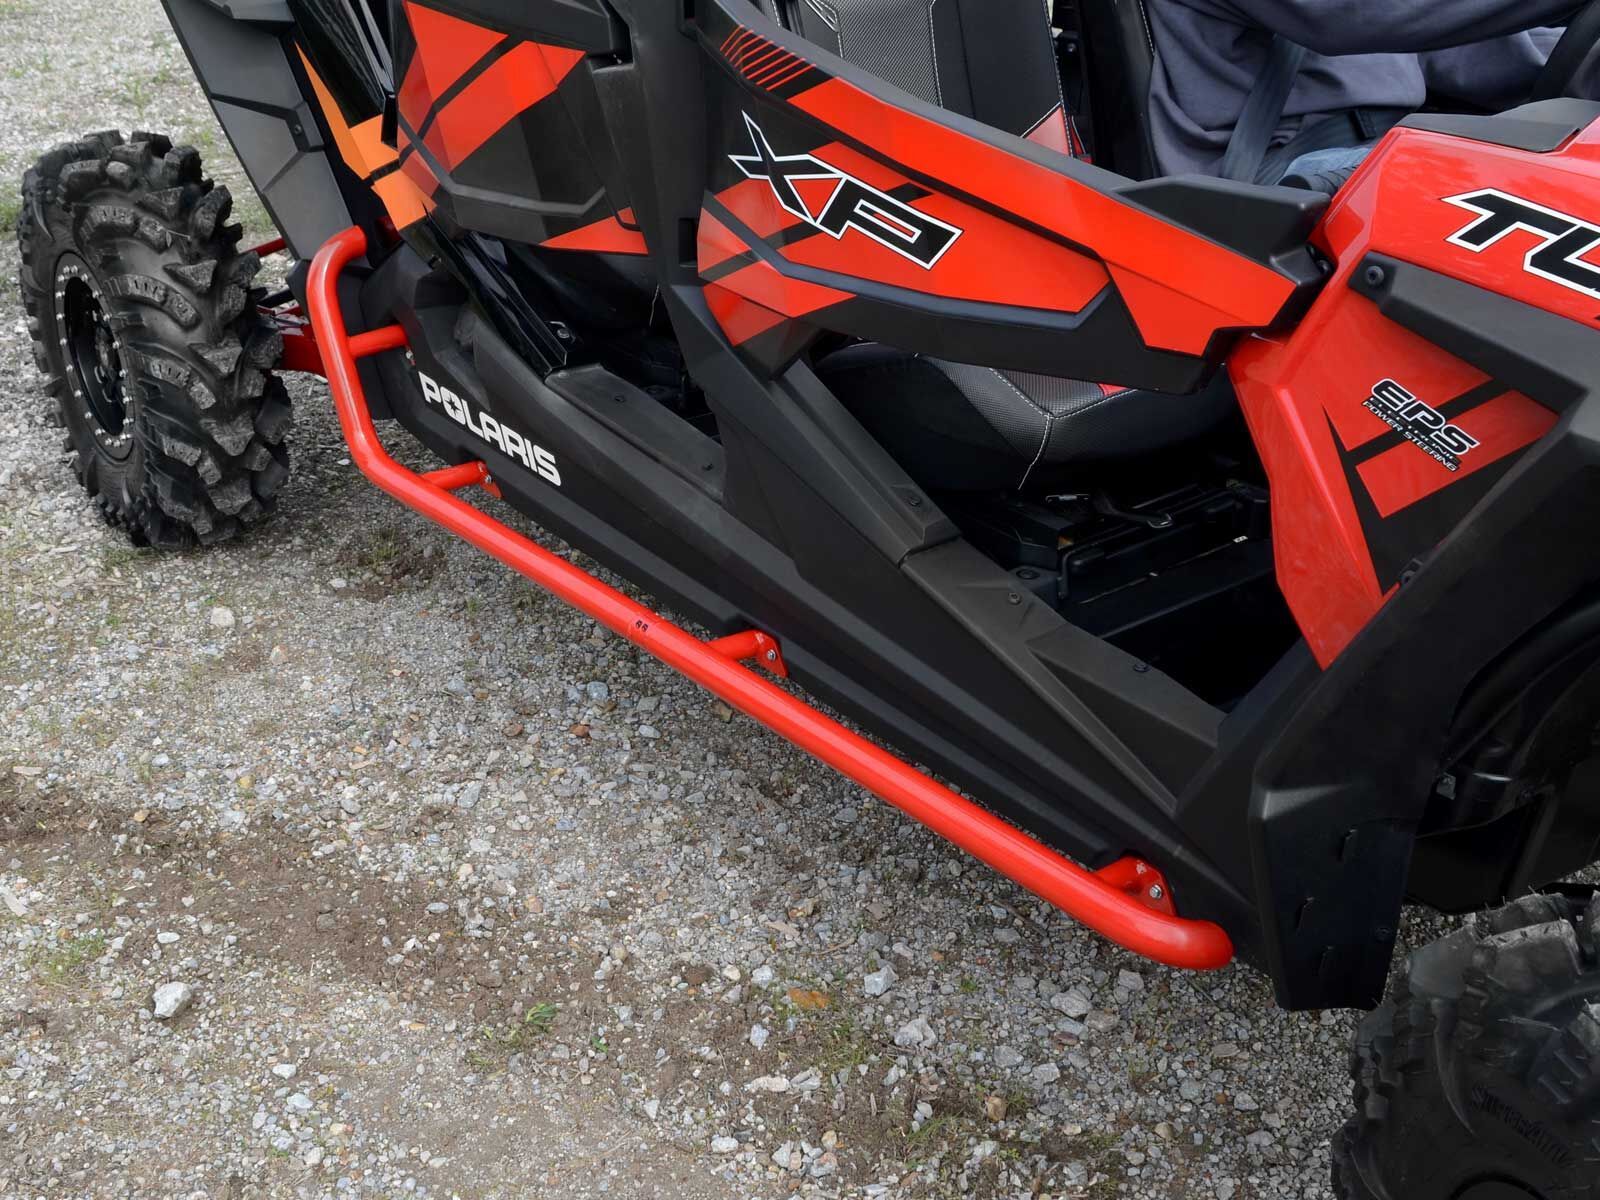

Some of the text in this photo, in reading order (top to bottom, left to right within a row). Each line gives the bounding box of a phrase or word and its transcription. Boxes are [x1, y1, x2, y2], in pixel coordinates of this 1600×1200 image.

[418, 371, 562, 487] POLARIS
[1362, 400, 1458, 472] POWER STEERING
[1371, 378, 1481, 455] EPS
